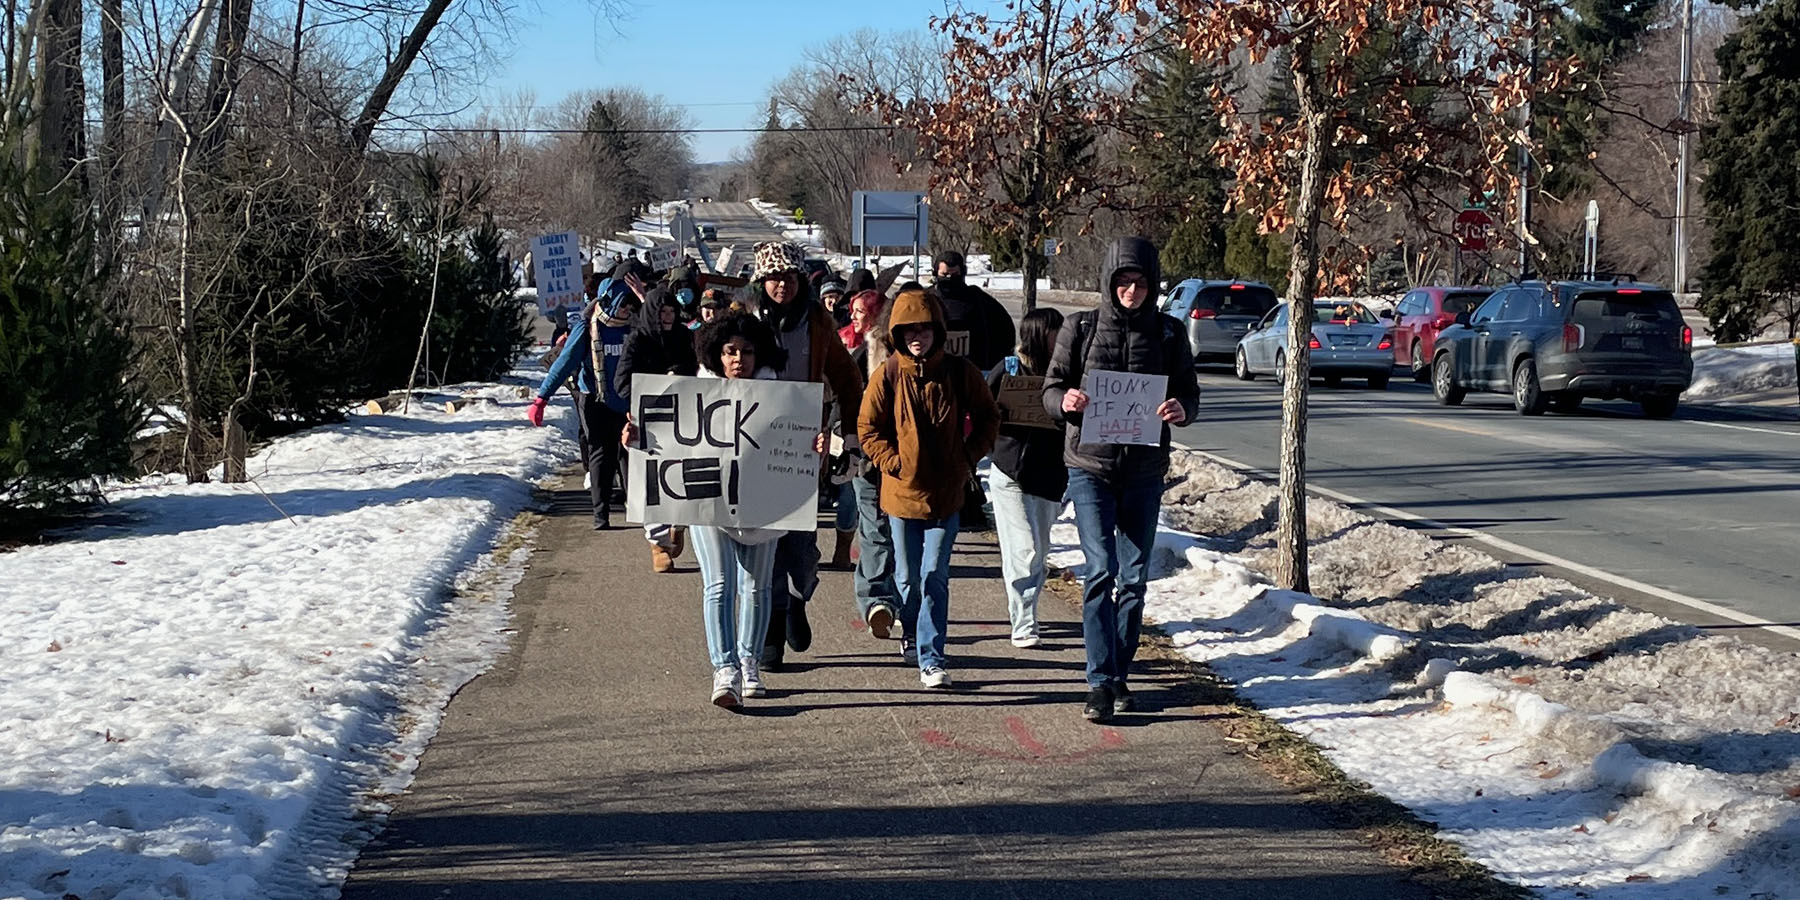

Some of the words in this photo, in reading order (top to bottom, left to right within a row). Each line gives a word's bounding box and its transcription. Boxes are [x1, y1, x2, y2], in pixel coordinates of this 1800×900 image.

[540, 234, 568, 246] LIBERTY
[548, 246, 564, 256] AND
[543, 257, 572, 269] JUSTICE
[551, 268, 566, 278] FOR
[547, 279, 570, 292] ALL
[1095, 376, 1150, 397] HONK
[1088, 401, 1115, 419] IF
[1127, 402, 1153, 416] YOU
[639, 393, 760, 456] FUCK
[1099, 418, 1142, 434] HATE
